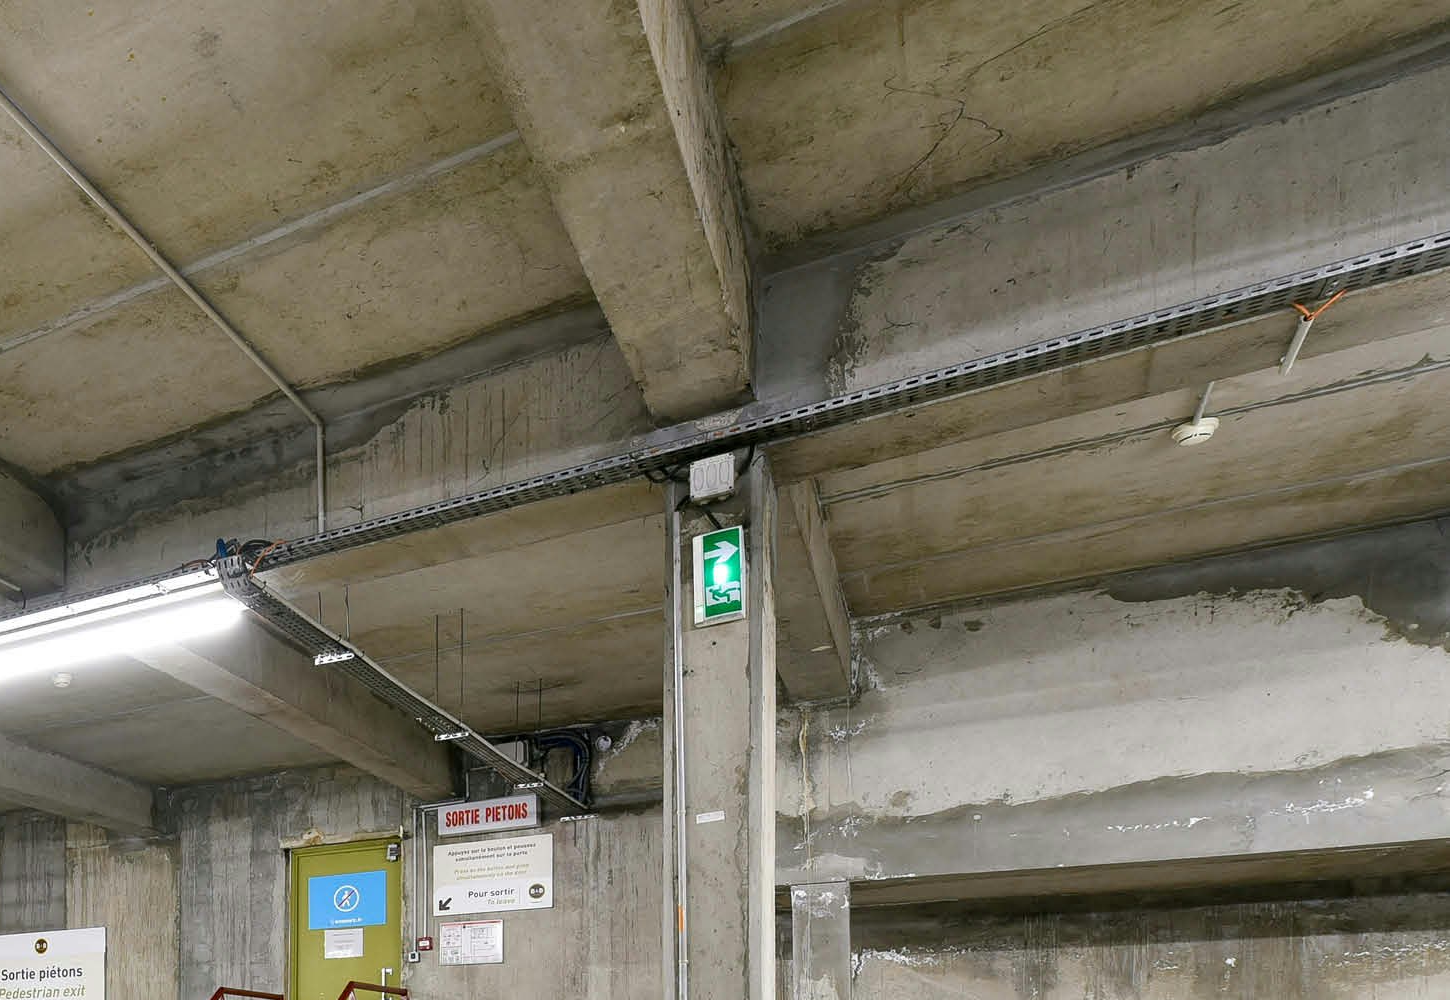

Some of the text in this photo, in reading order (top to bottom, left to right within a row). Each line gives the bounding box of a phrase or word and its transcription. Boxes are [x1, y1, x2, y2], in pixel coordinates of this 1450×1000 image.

[445, 802, 528, 828] SORTIE PIETONS
[468, 887, 515, 898] Pour sortir
[1, 965, 83, 982] Sortie piétons
[63, 984, 86, 998] exit
